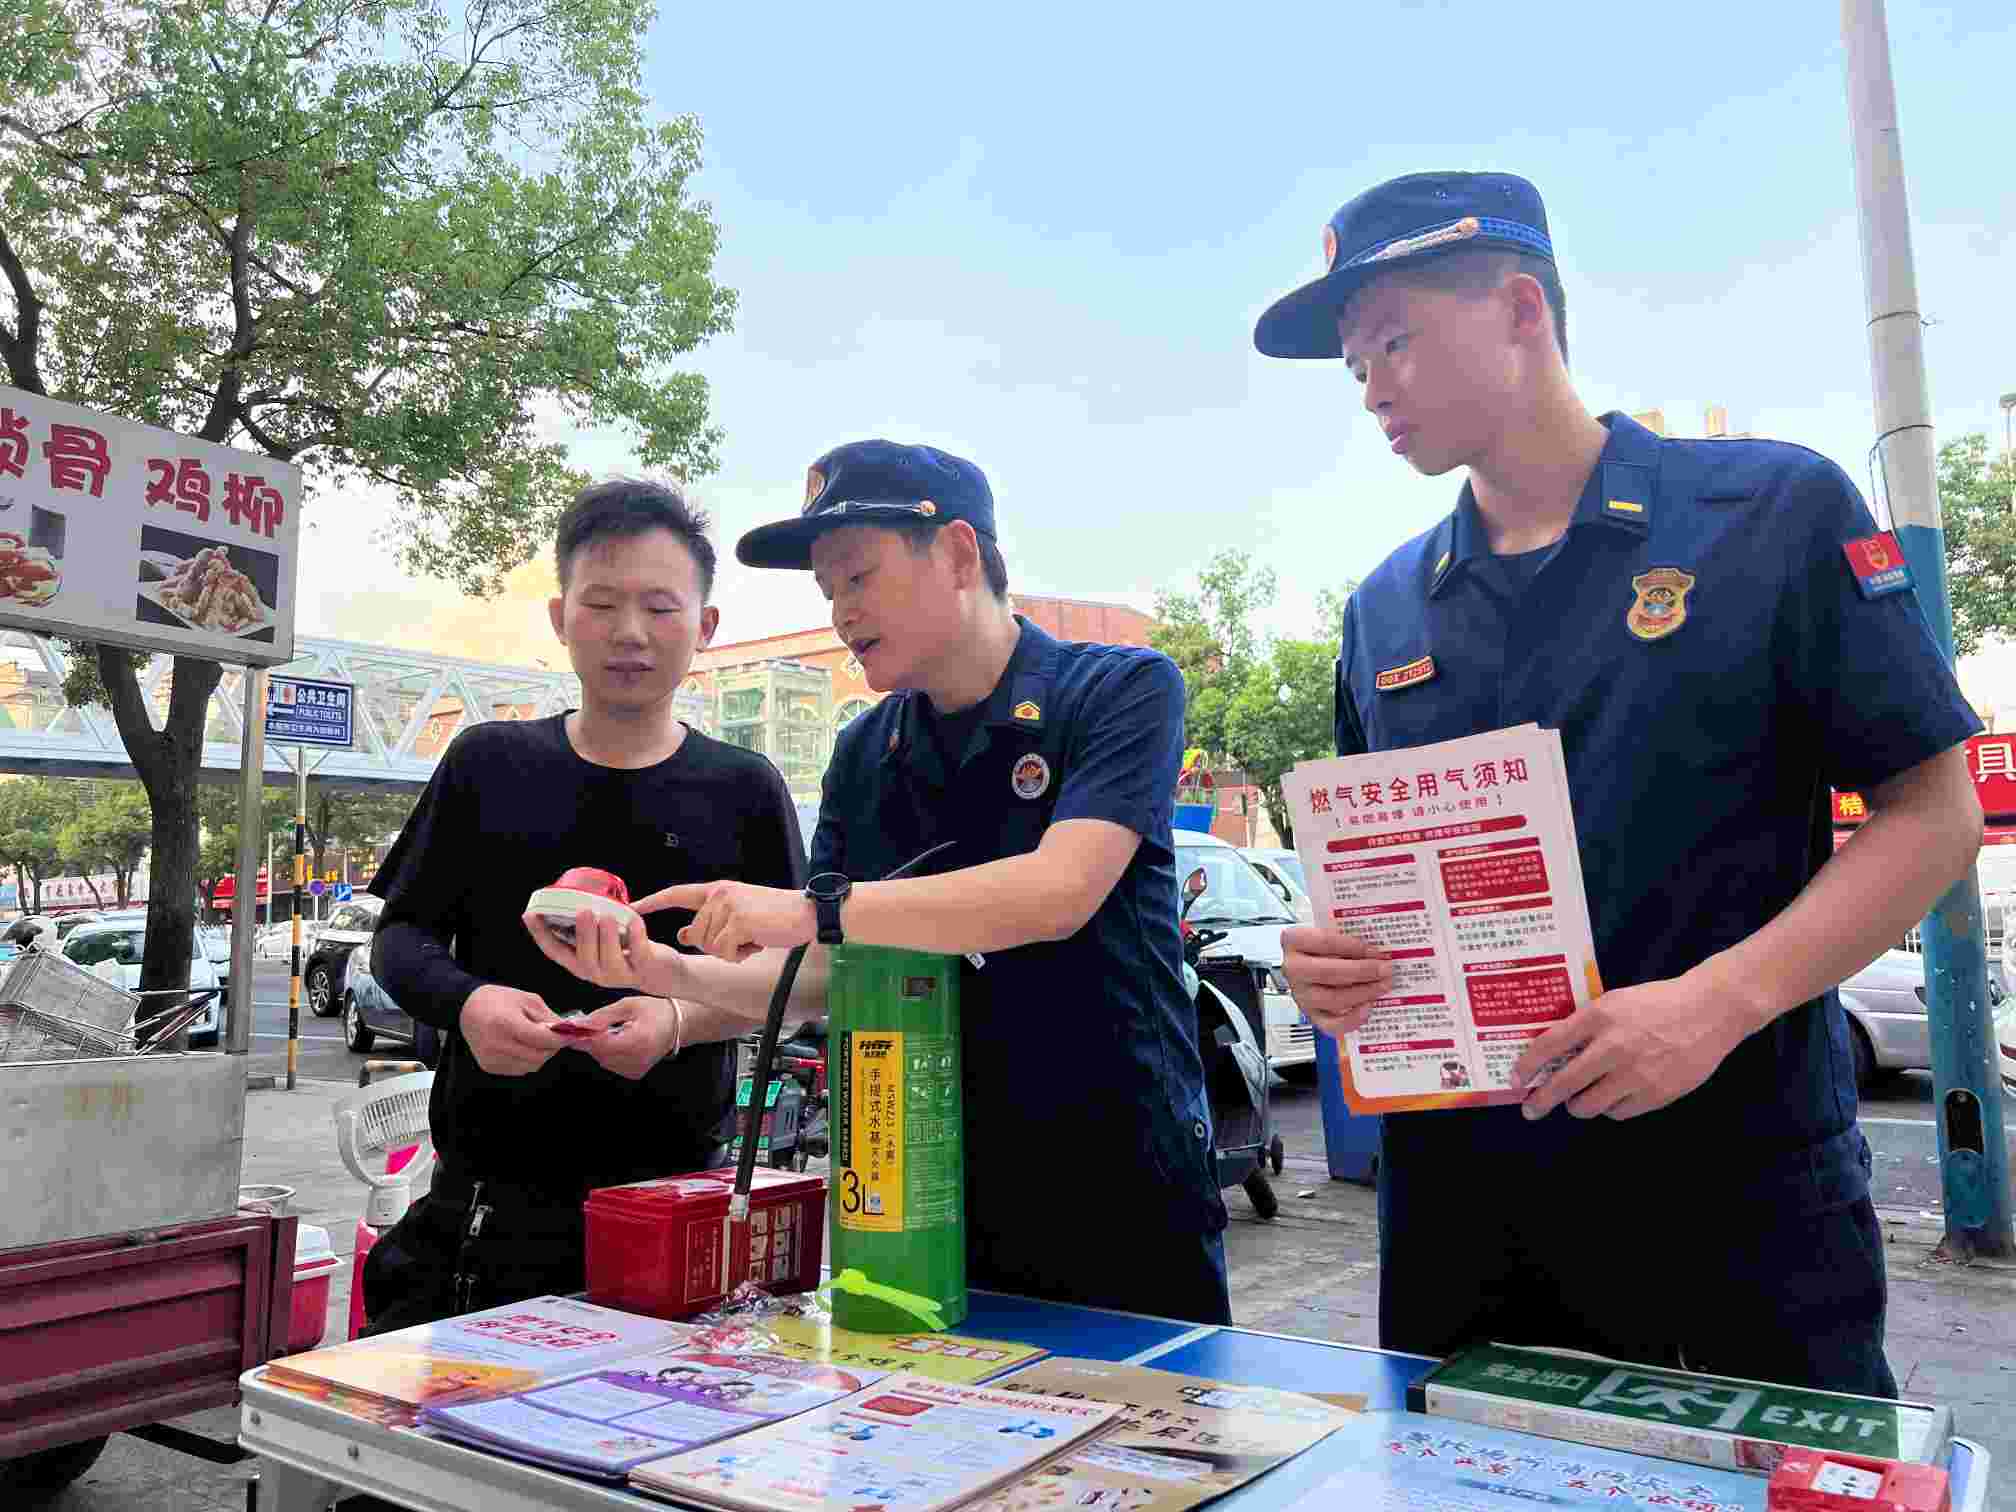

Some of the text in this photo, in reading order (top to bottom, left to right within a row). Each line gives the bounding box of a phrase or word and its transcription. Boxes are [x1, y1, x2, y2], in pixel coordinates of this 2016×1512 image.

[146, 457, 285, 538] 鸡柳
[1310, 757, 1529, 816] 燃气安全用气须知
[842, 1170, 885, 1215] 3L
[1760, 1405, 1888, 1438] EXIT
